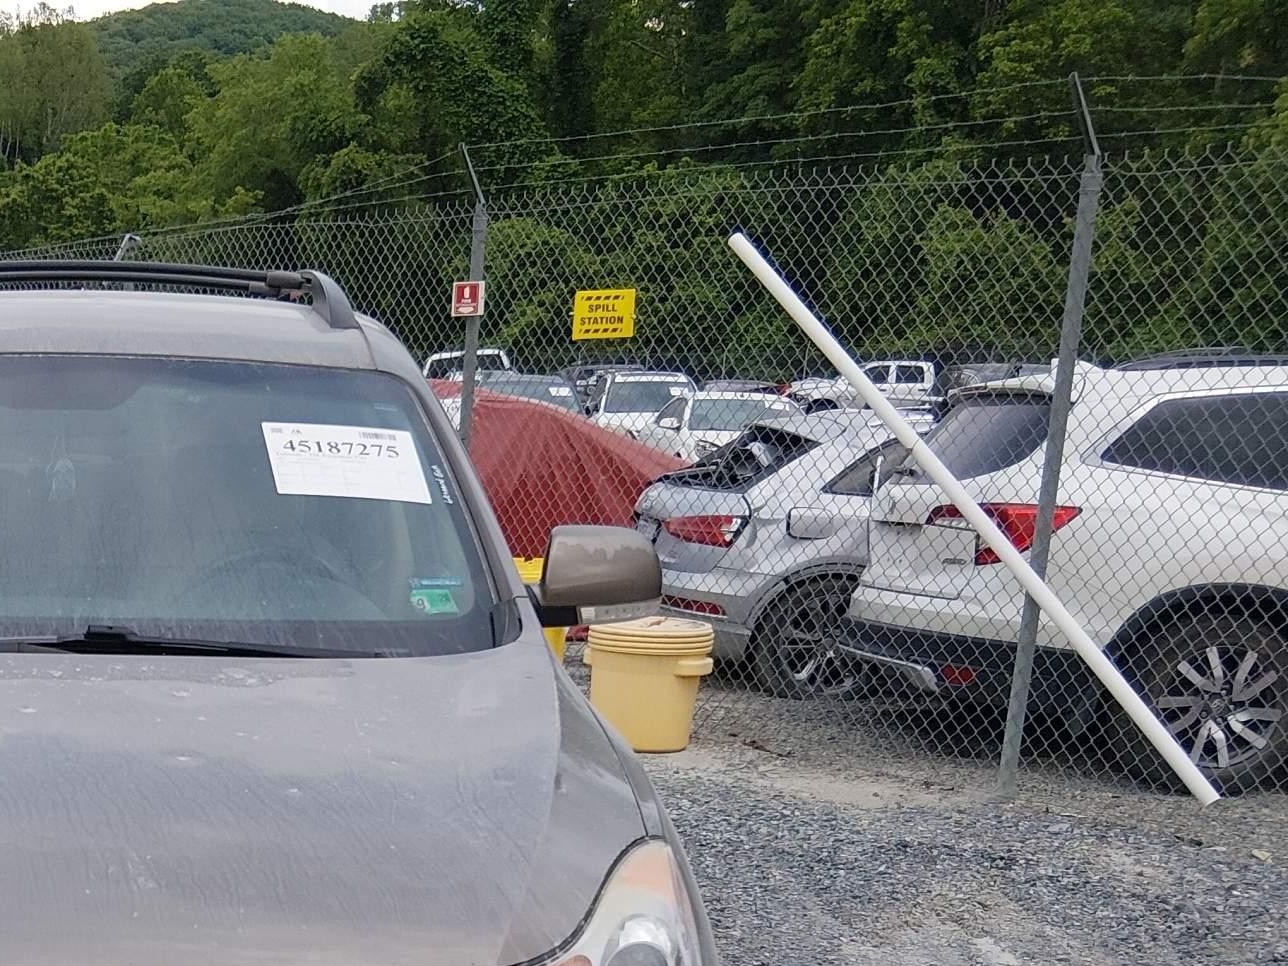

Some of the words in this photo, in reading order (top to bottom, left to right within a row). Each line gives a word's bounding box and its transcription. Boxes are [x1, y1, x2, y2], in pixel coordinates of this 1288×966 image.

[587, 303, 618, 313] SPILL
[579, 315, 624, 326] STATION
[282, 439, 400, 459] 45187275
